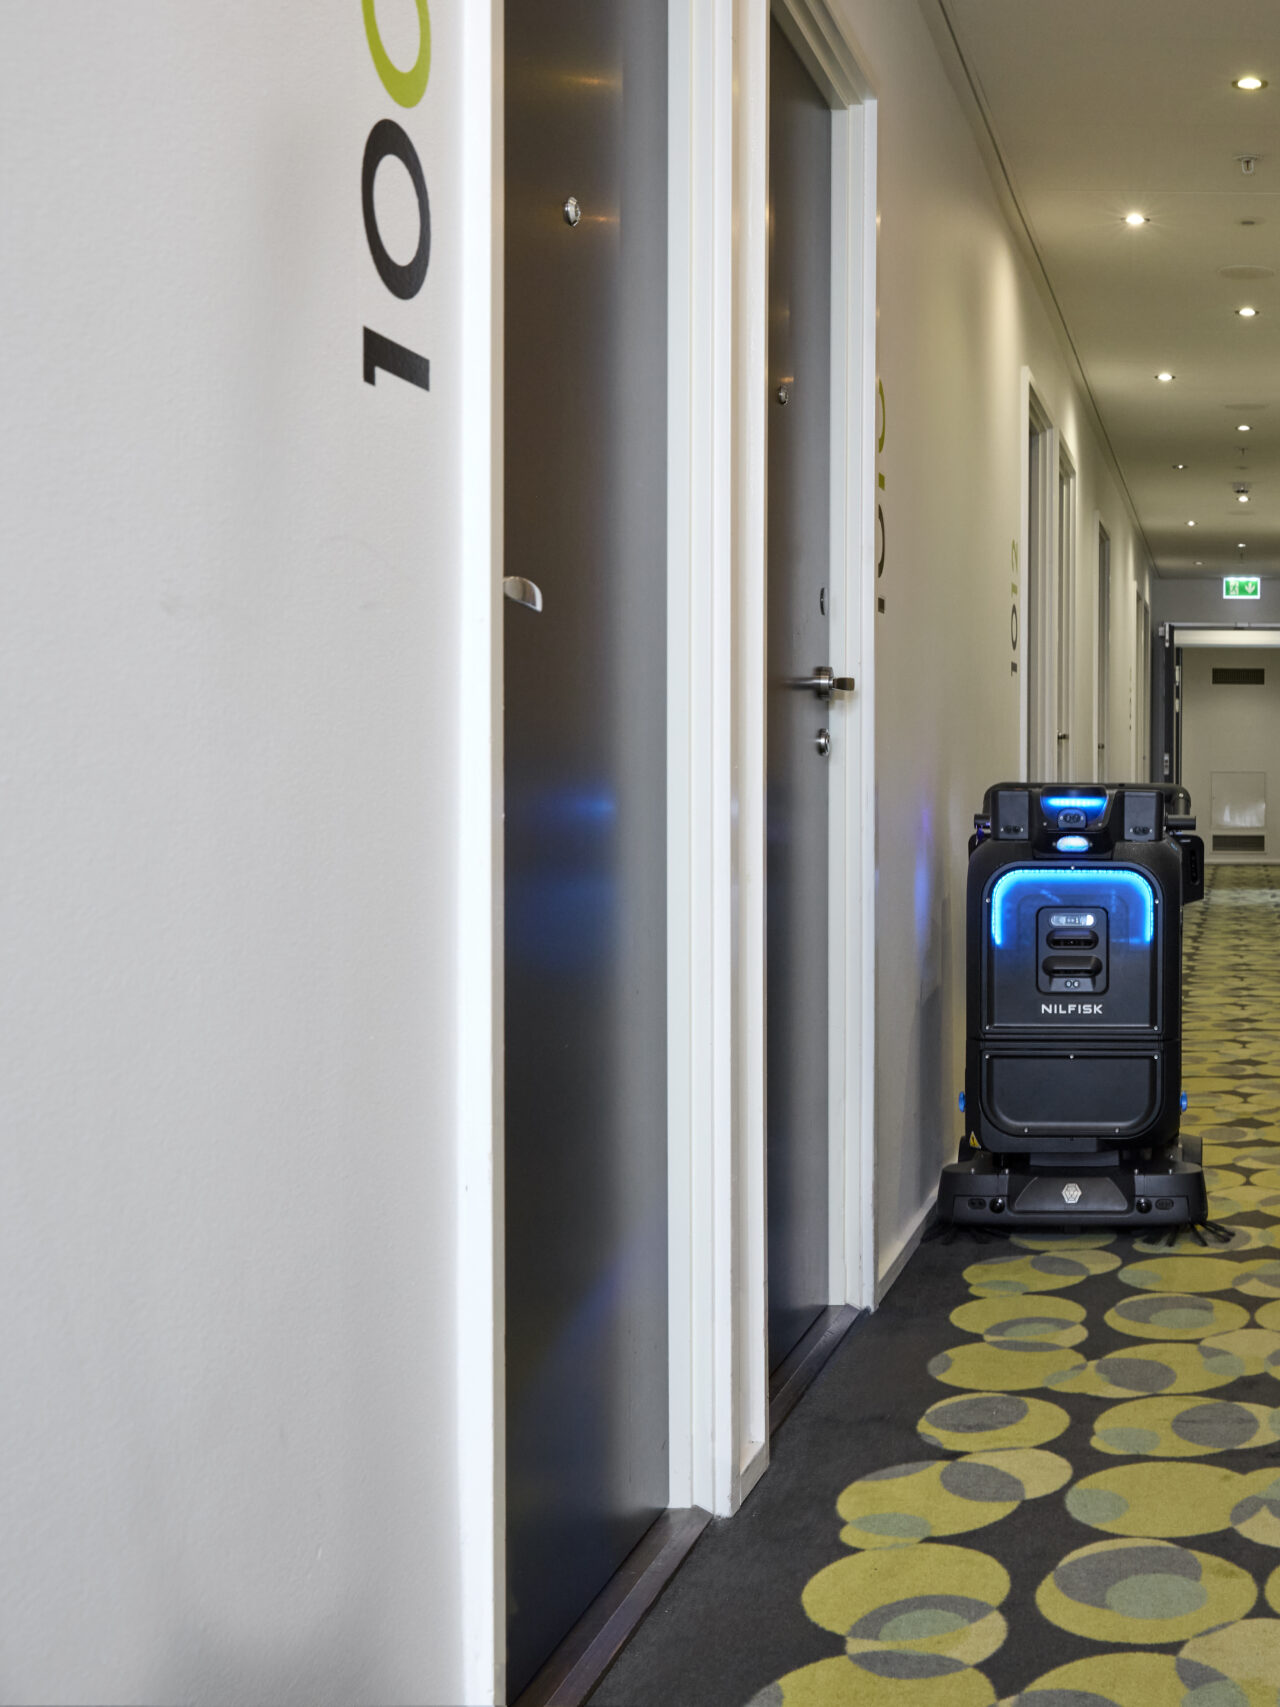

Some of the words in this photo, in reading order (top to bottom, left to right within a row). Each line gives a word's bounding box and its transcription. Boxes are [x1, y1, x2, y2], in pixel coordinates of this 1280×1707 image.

[362, 0, 431, 391] 100
[1010, 539, 1018, 677] 1012
[1041, 1004, 1103, 1014] NILFISK
